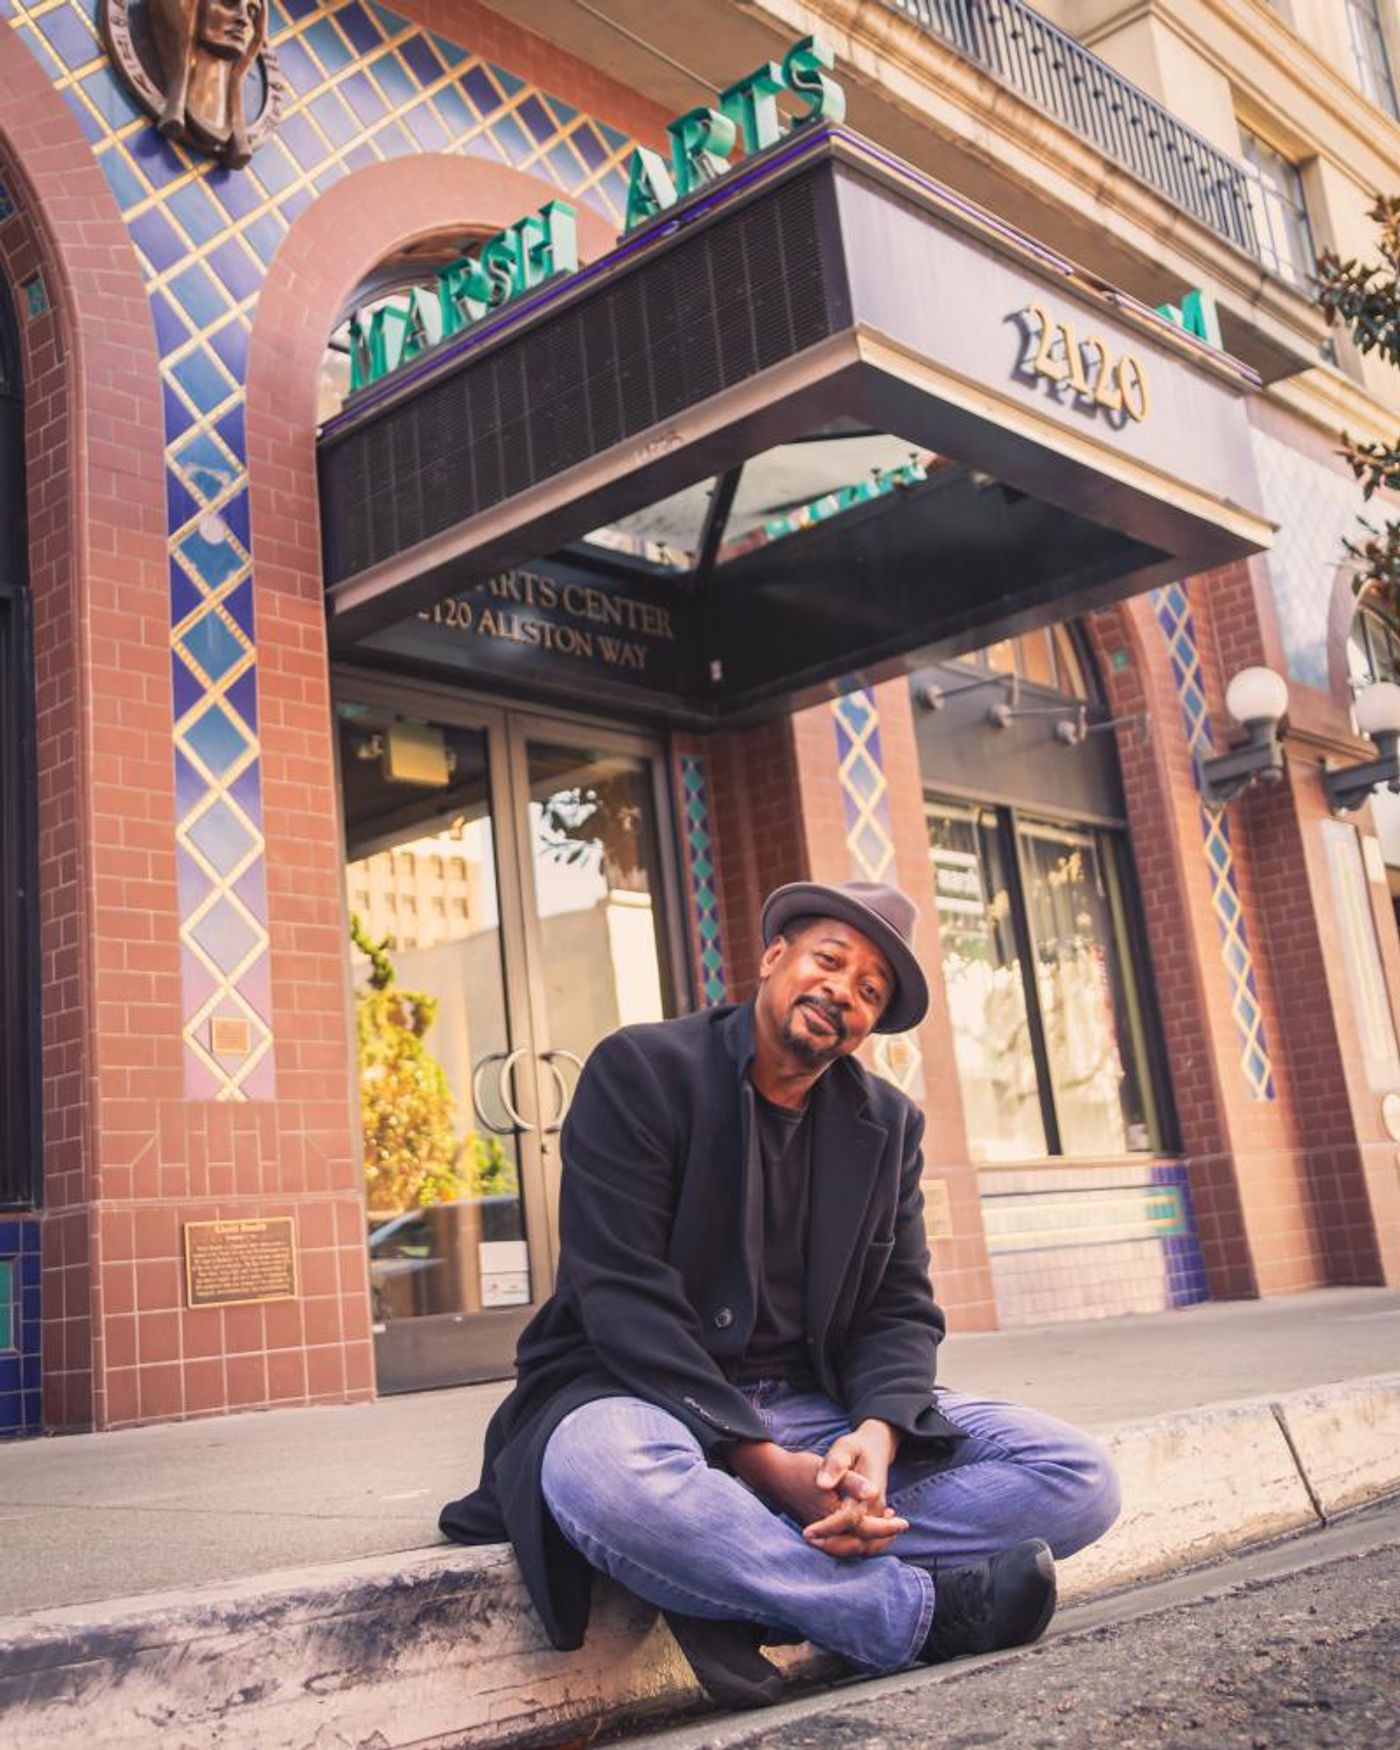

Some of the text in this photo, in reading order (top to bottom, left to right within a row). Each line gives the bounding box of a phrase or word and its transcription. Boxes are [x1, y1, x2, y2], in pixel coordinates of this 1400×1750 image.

[624, 34, 846, 233] ARTS
[1027, 302, 1149, 423] 2120
[476, 608, 593, 658] ALLSTON
[598, 634, 647, 670] WAY
[562, 583, 675, 641] CENTER
